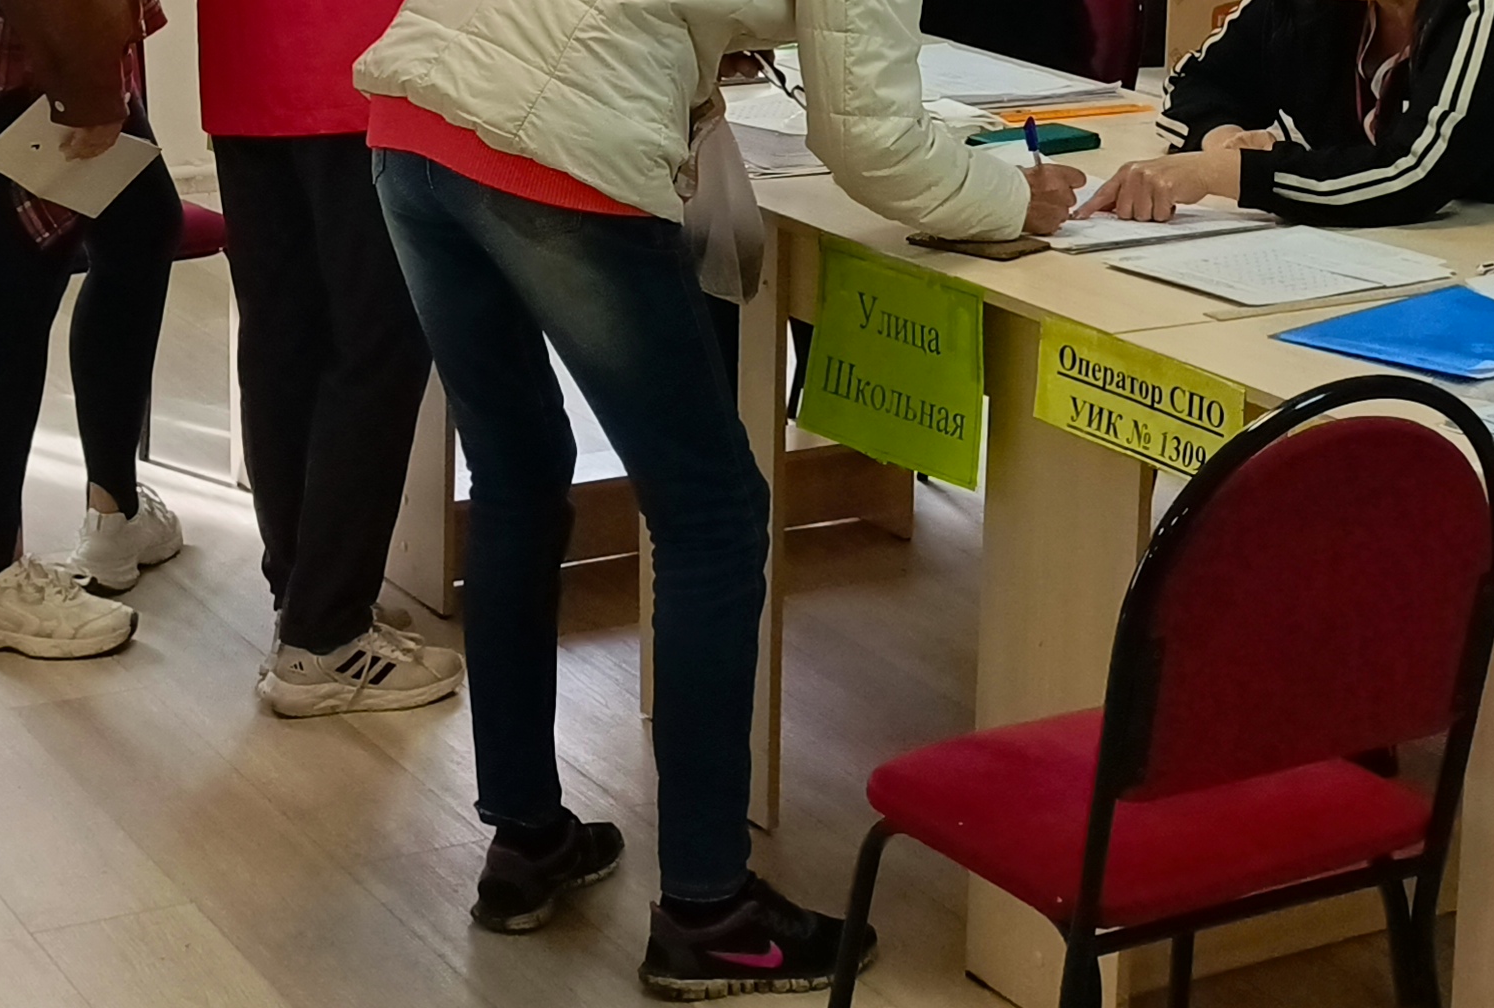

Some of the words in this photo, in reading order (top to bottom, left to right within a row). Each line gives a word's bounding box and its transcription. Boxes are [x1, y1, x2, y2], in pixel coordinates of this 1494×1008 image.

[857, 291, 941, 356] Улица
[822, 356, 966, 441] Школьная
[1058, 344, 1163, 408] Оператор
[1170, 386, 1225, 428] СПО
[1069, 395, 1123, 439] УИК
[1126, 419, 1151, 450] №
[1159, 432, 1207, 470] 1309
